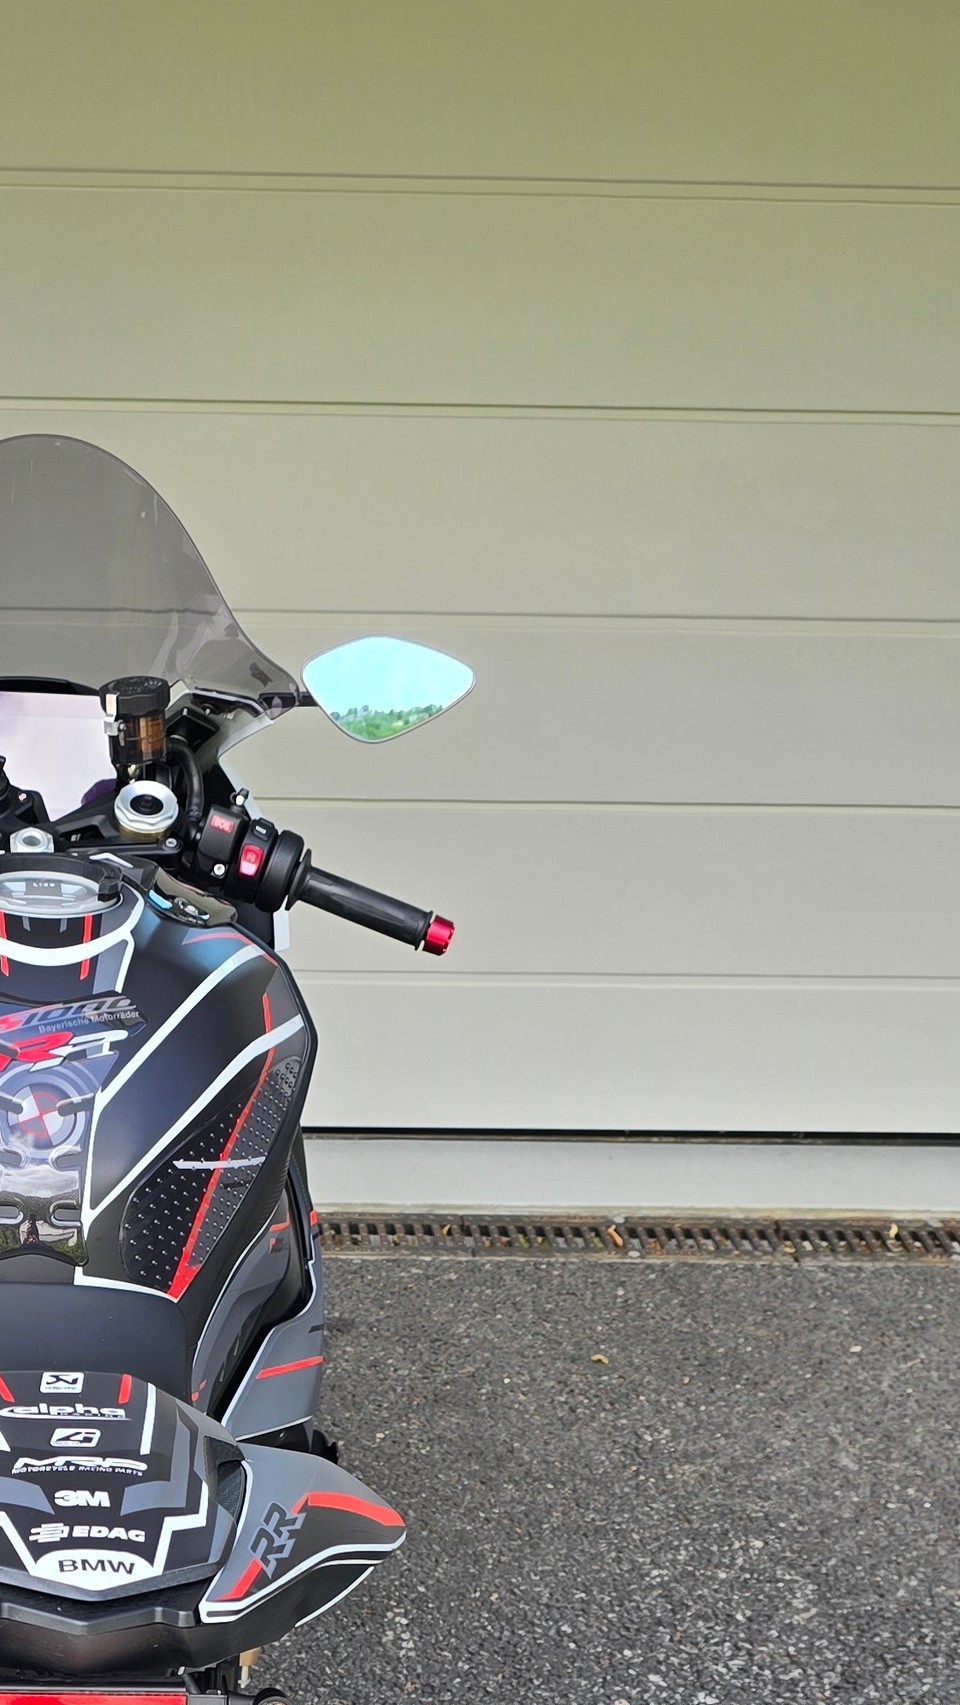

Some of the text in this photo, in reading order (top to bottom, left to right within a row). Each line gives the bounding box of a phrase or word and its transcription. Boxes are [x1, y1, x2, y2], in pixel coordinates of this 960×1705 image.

[38, 1018, 89, 1034] Bayerische
[0, 1403, 127, 1420] alpha
[78, 1465, 112, 1473] RACING
[114, 1467, 143, 1477] PARTS
[54, 1490, 111, 1508] 3M
[72, 1525, 146, 1543] EDAG
[58, 1559, 136, 1575] BMW
